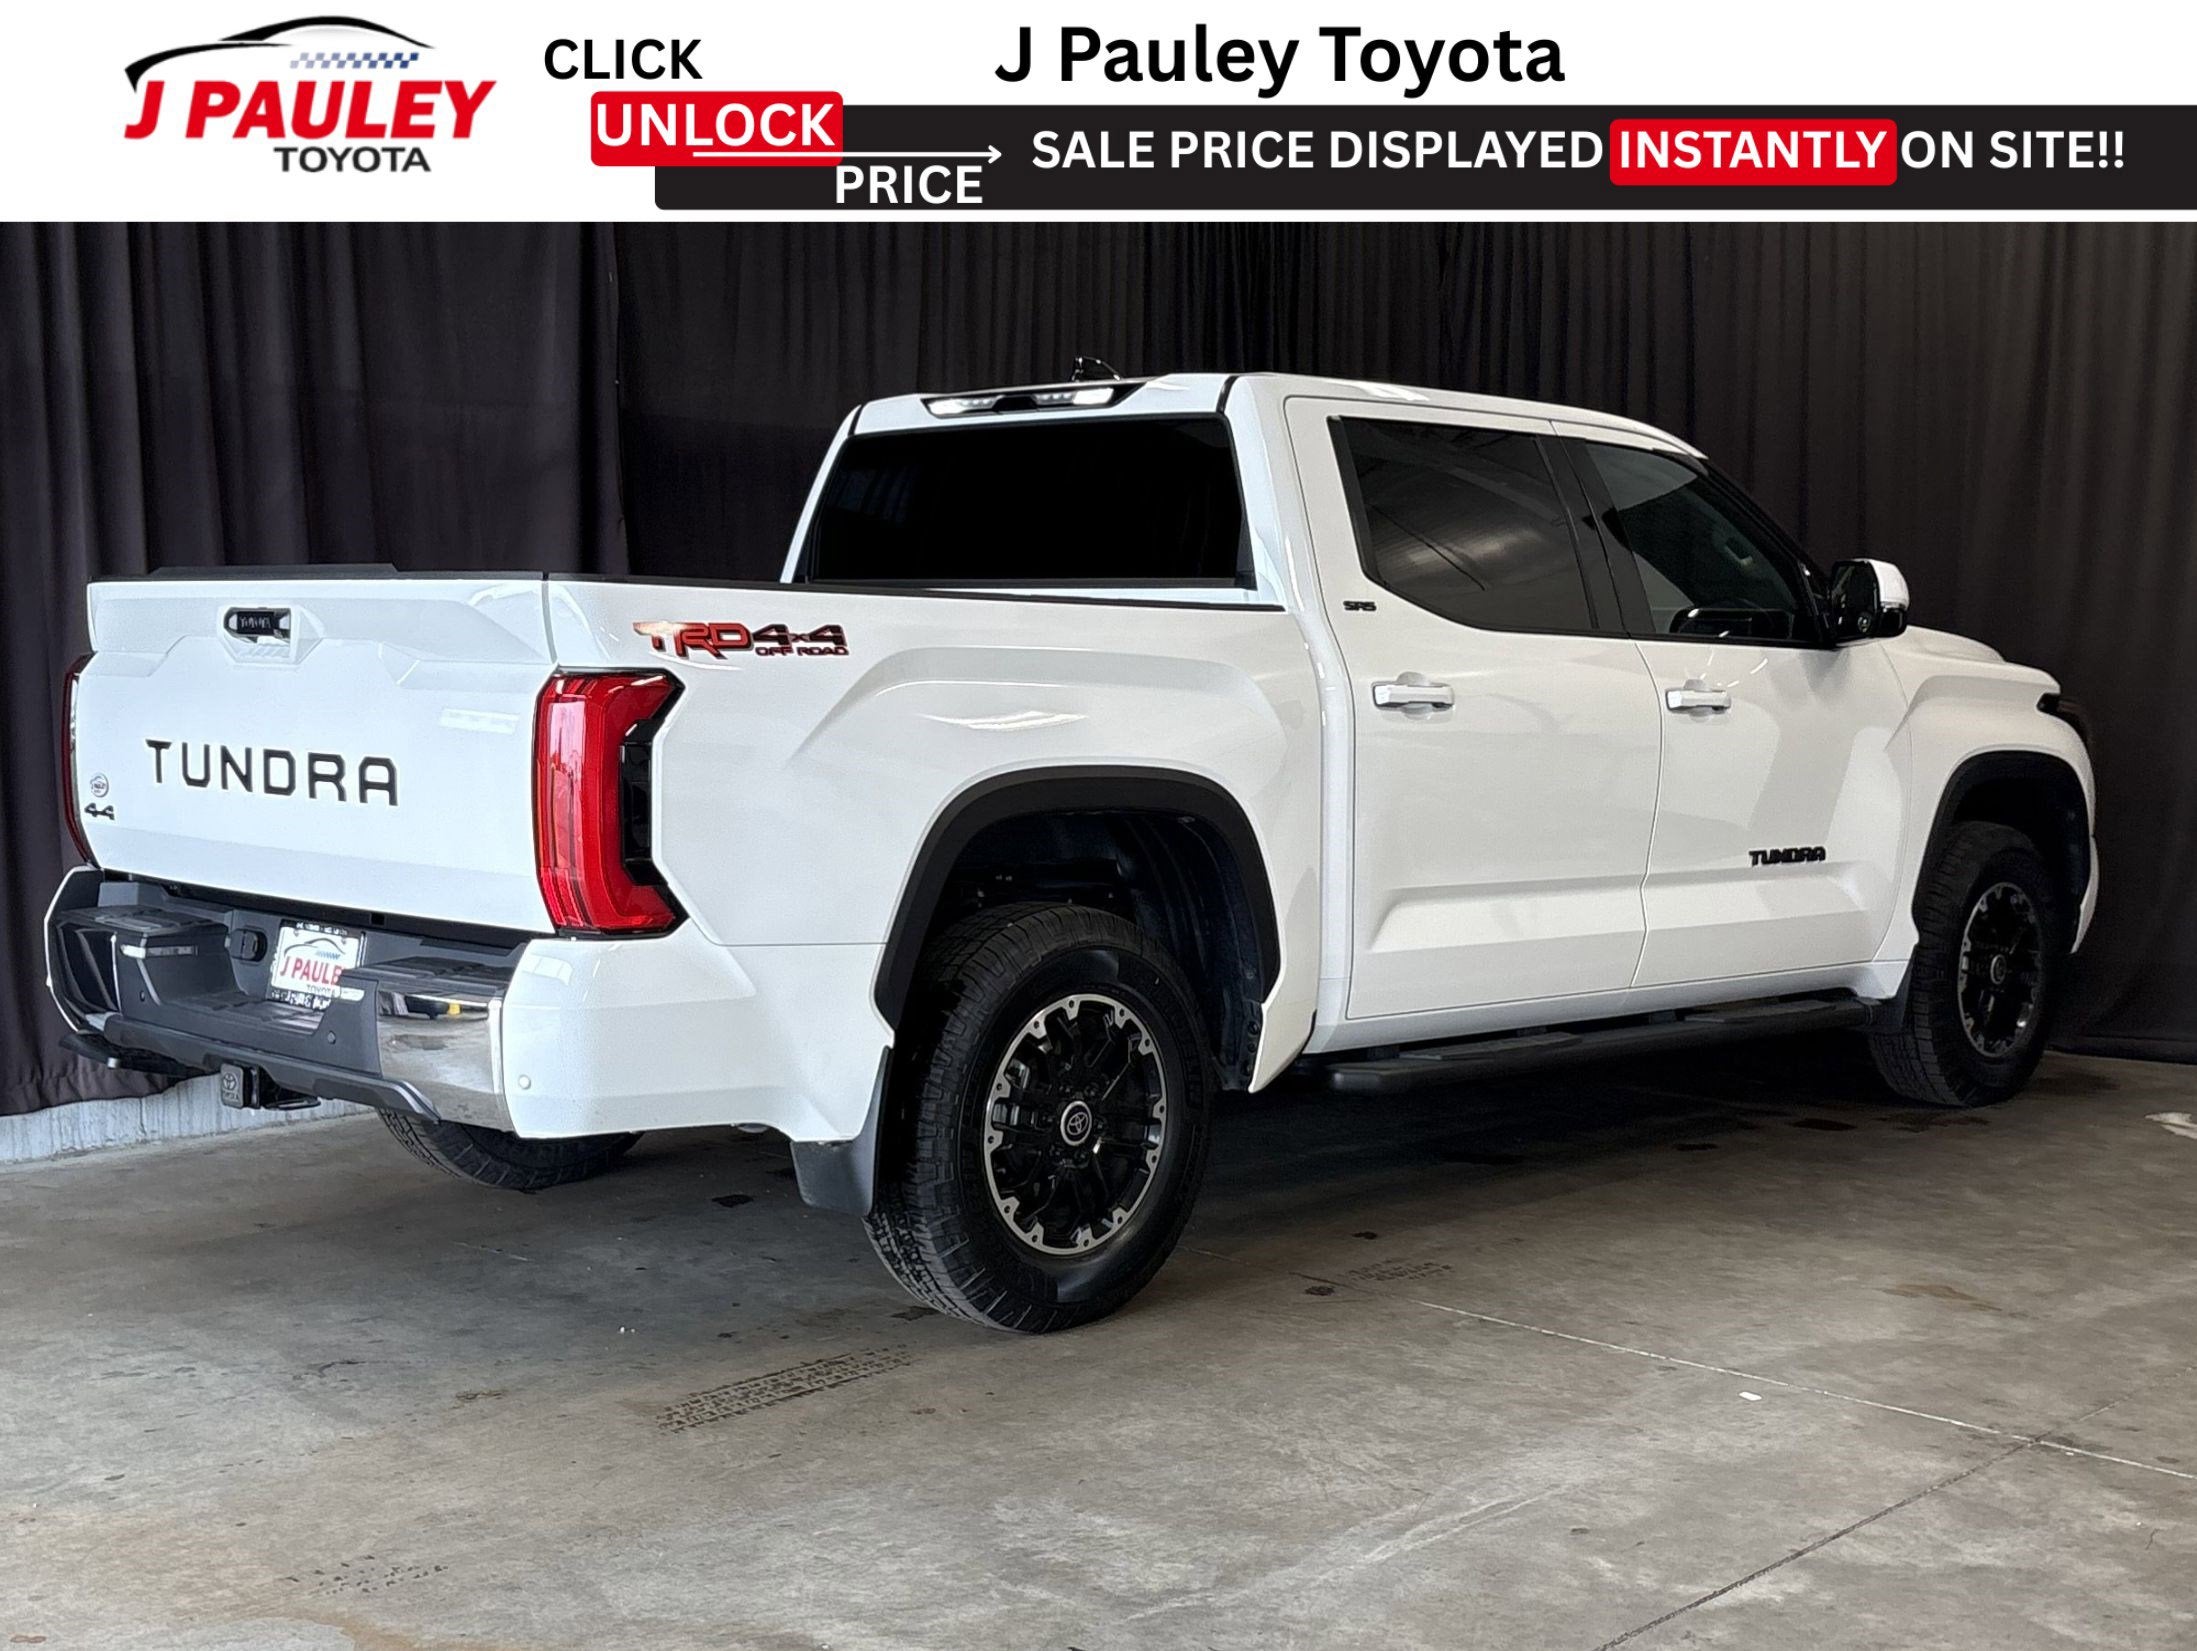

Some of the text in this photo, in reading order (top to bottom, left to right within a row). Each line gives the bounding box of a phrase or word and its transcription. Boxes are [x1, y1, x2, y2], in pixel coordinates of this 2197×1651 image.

[632, 620, 752, 659] TRD
[755, 646, 849, 656] OFF ROAD
[145, 739, 398, 806] TUNDRA
[1748, 845, 1826, 867] TUNDRA
[280, 955, 344, 986] J PAULE
